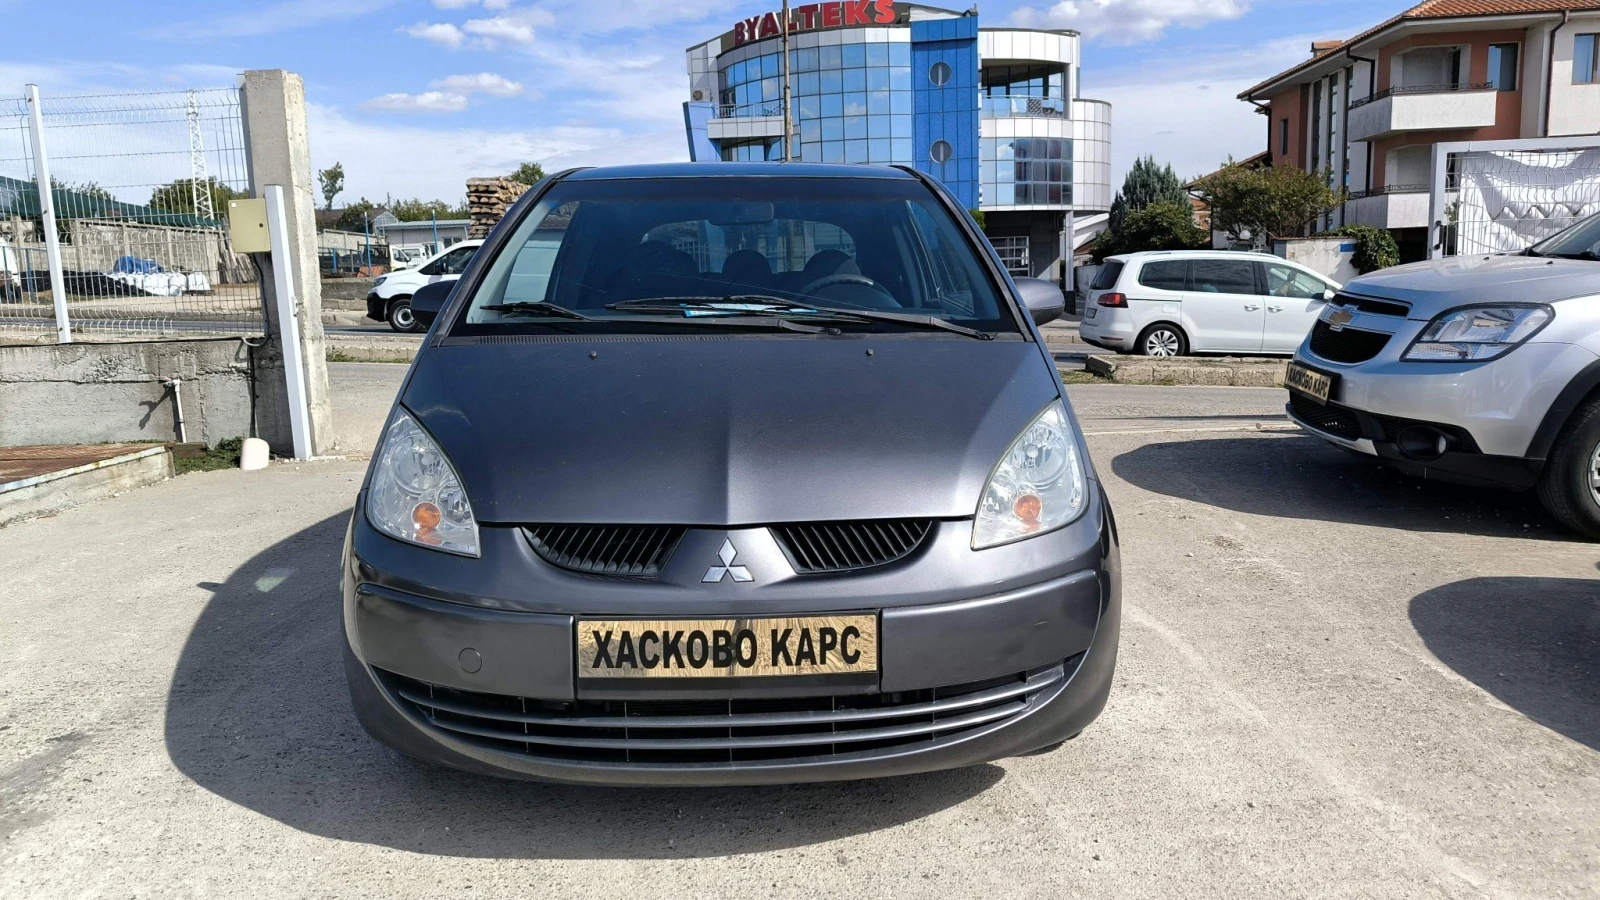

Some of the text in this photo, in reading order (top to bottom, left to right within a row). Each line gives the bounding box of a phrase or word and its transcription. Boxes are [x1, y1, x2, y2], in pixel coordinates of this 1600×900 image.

[734, 0, 896, 46] BYALTEKS
[591, 625, 861, 669] ХАСКОВО КАРС
